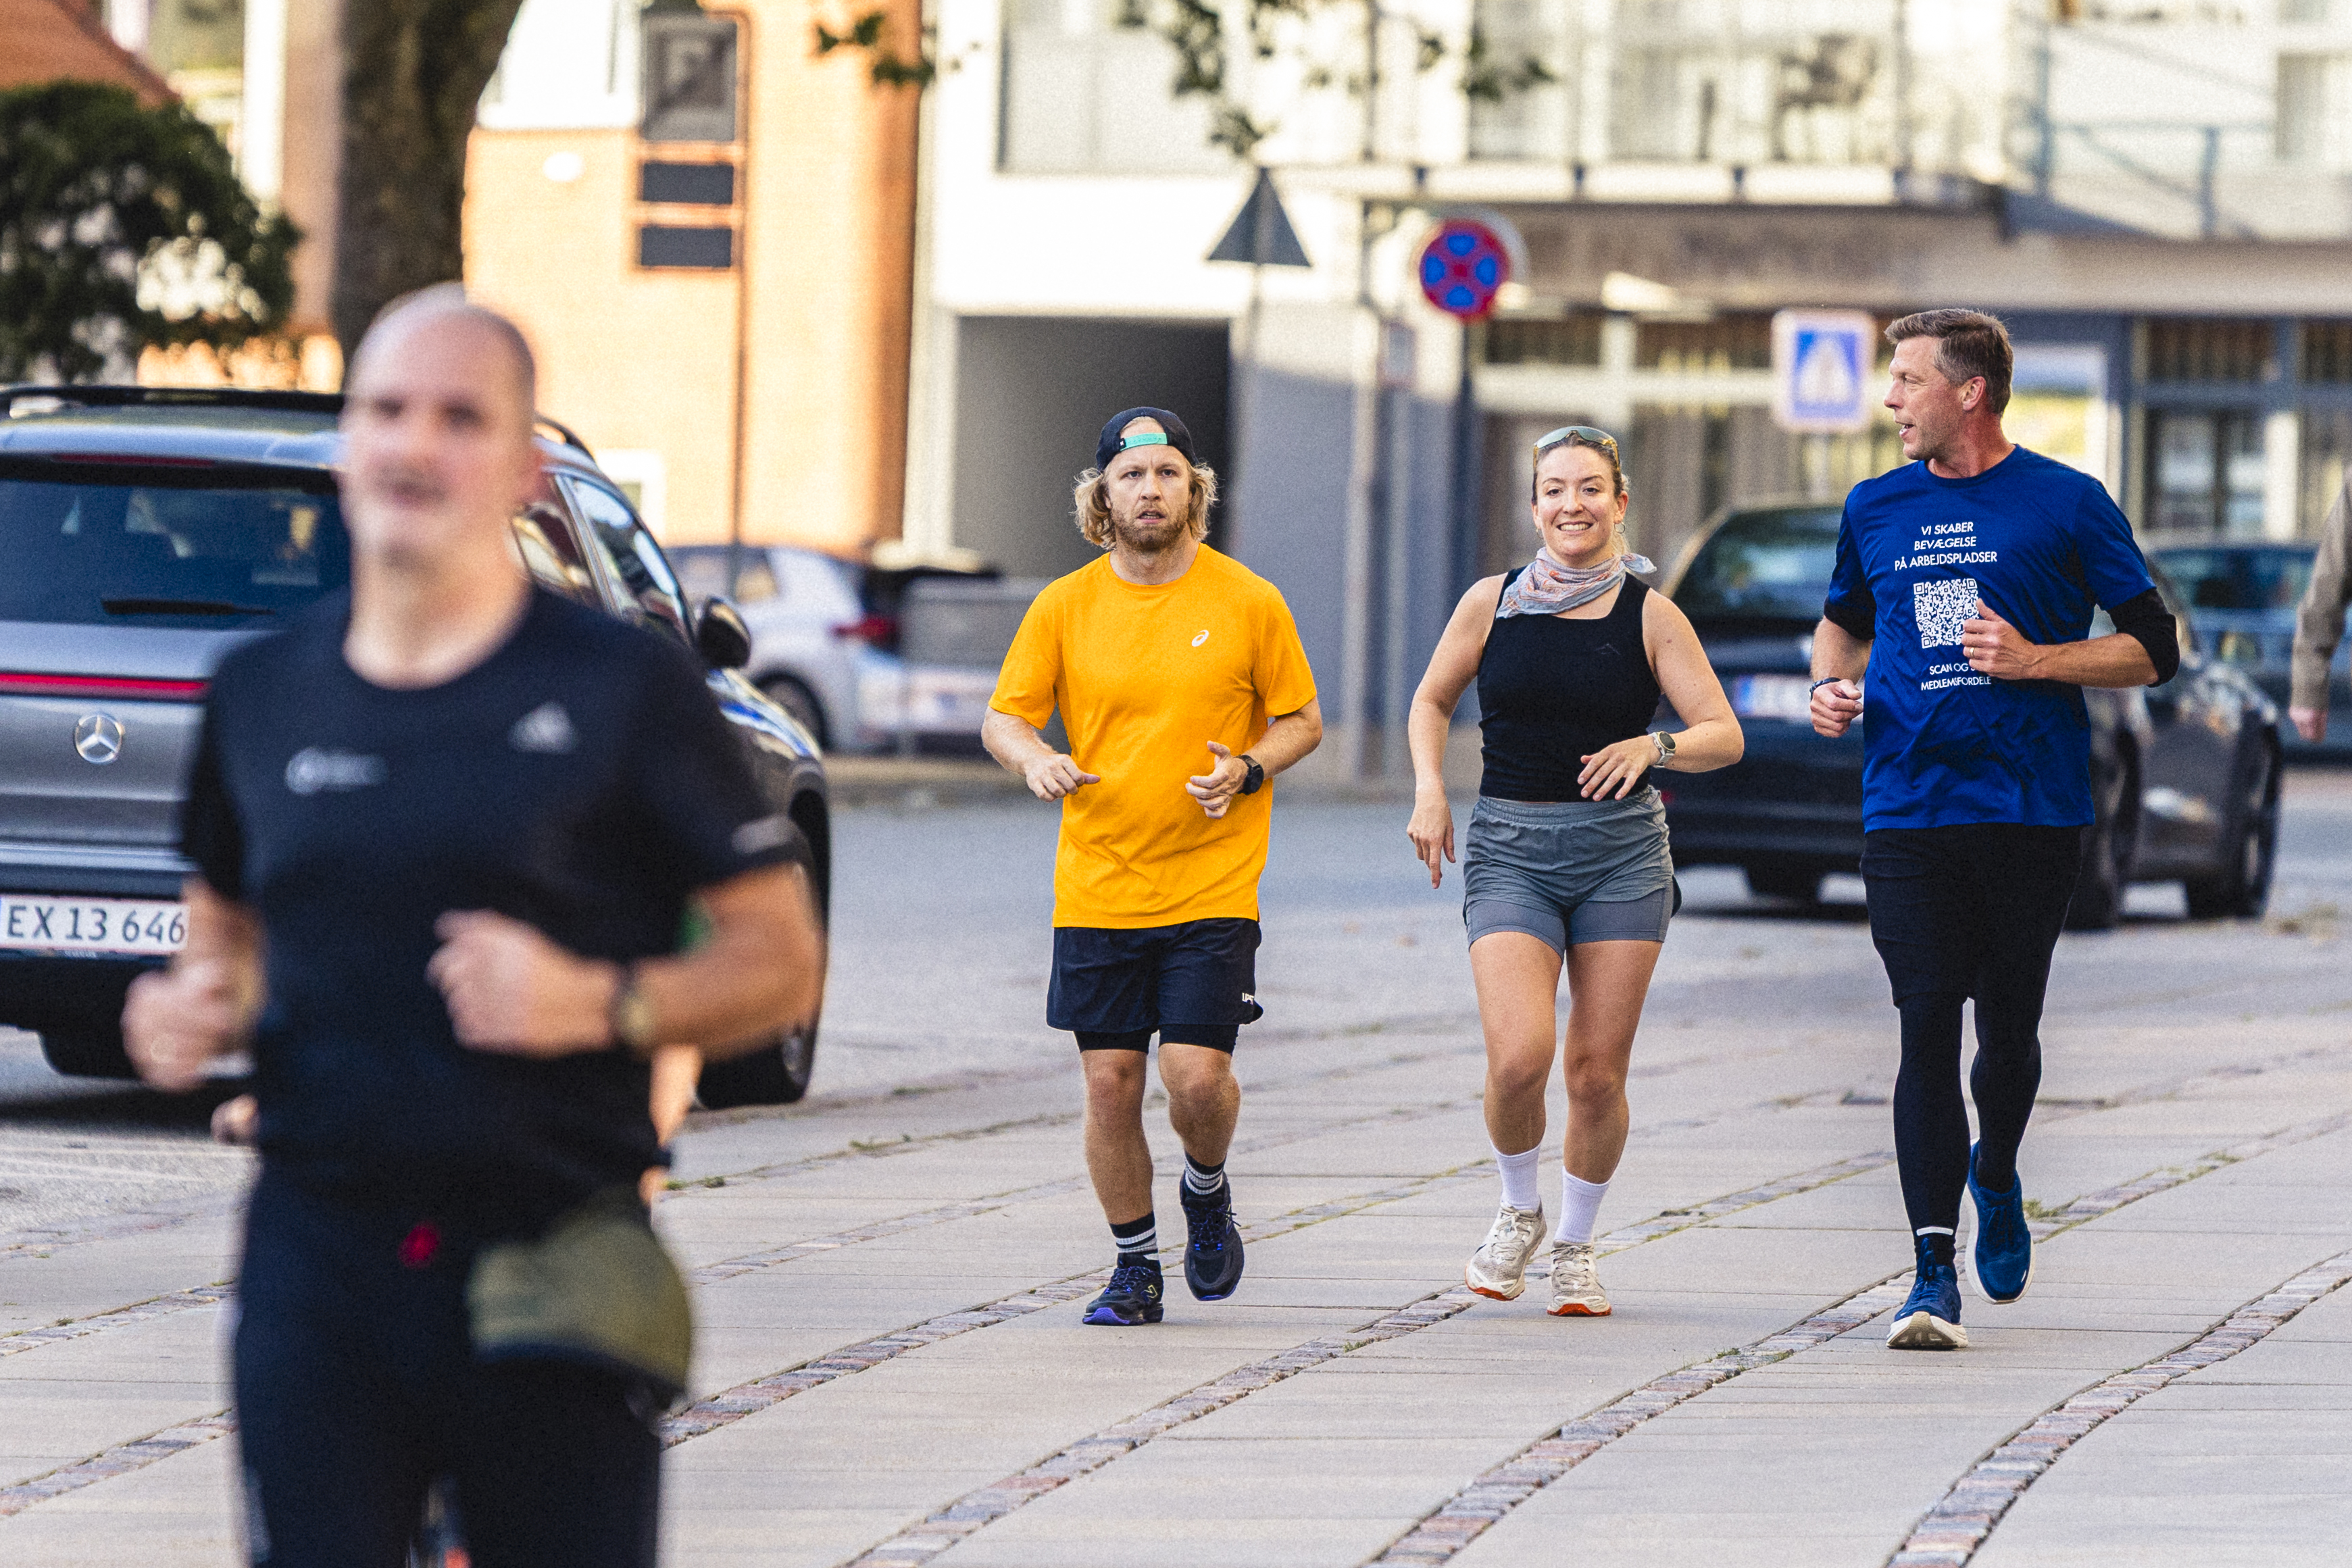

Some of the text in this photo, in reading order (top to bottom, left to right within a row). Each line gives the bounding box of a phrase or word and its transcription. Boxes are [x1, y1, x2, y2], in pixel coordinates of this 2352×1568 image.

[1921, 522, 1974, 536] VI SKABER
[1913, 536, 1977, 551] BEVÆGELSE
[1895, 551, 1997, 571] PÅ ARBEJDSPLADSER
[1929, 663, 1953, 676] SCAN
[1953, 663, 1969, 672] OG
[1921, 676, 1992, 690] MEDLEMSFORDELE
[7, 905, 186, 944] EX 13 646
